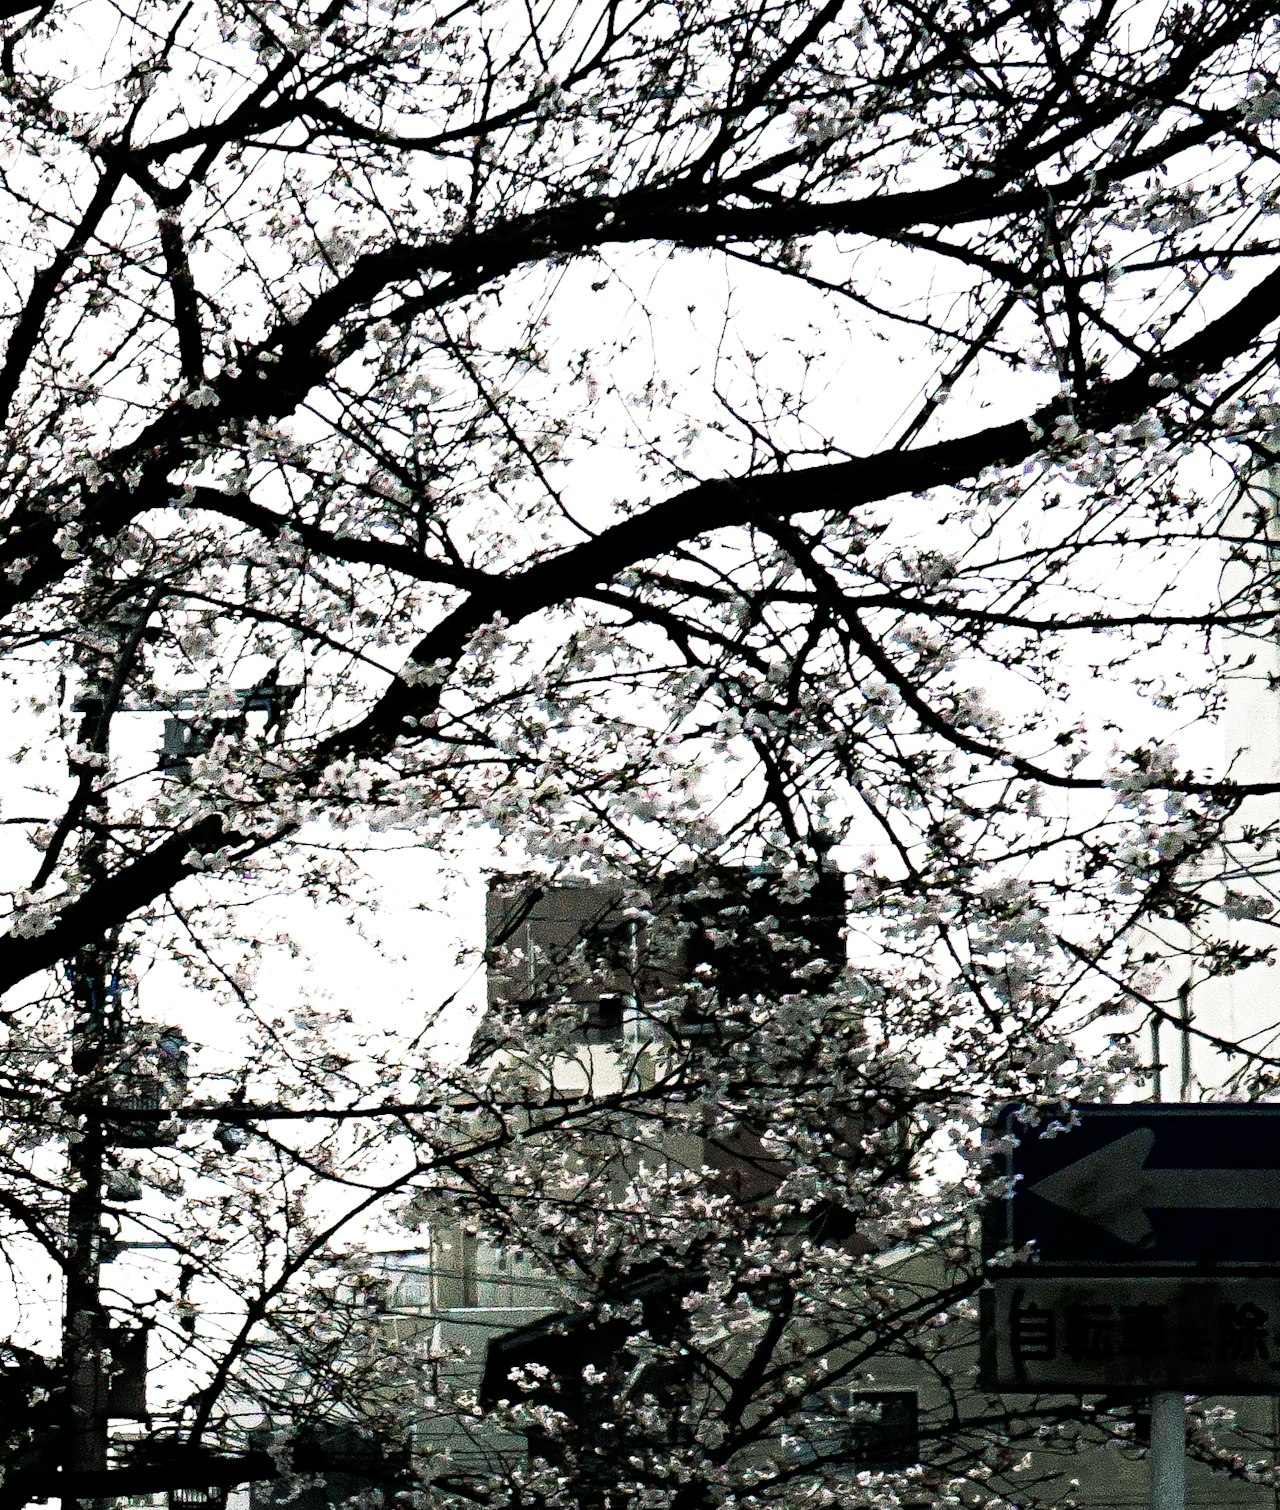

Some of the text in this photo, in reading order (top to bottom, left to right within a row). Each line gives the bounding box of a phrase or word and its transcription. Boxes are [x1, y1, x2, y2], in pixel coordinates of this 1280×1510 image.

[1013, 1301, 1280, 1364] 自転車を除
